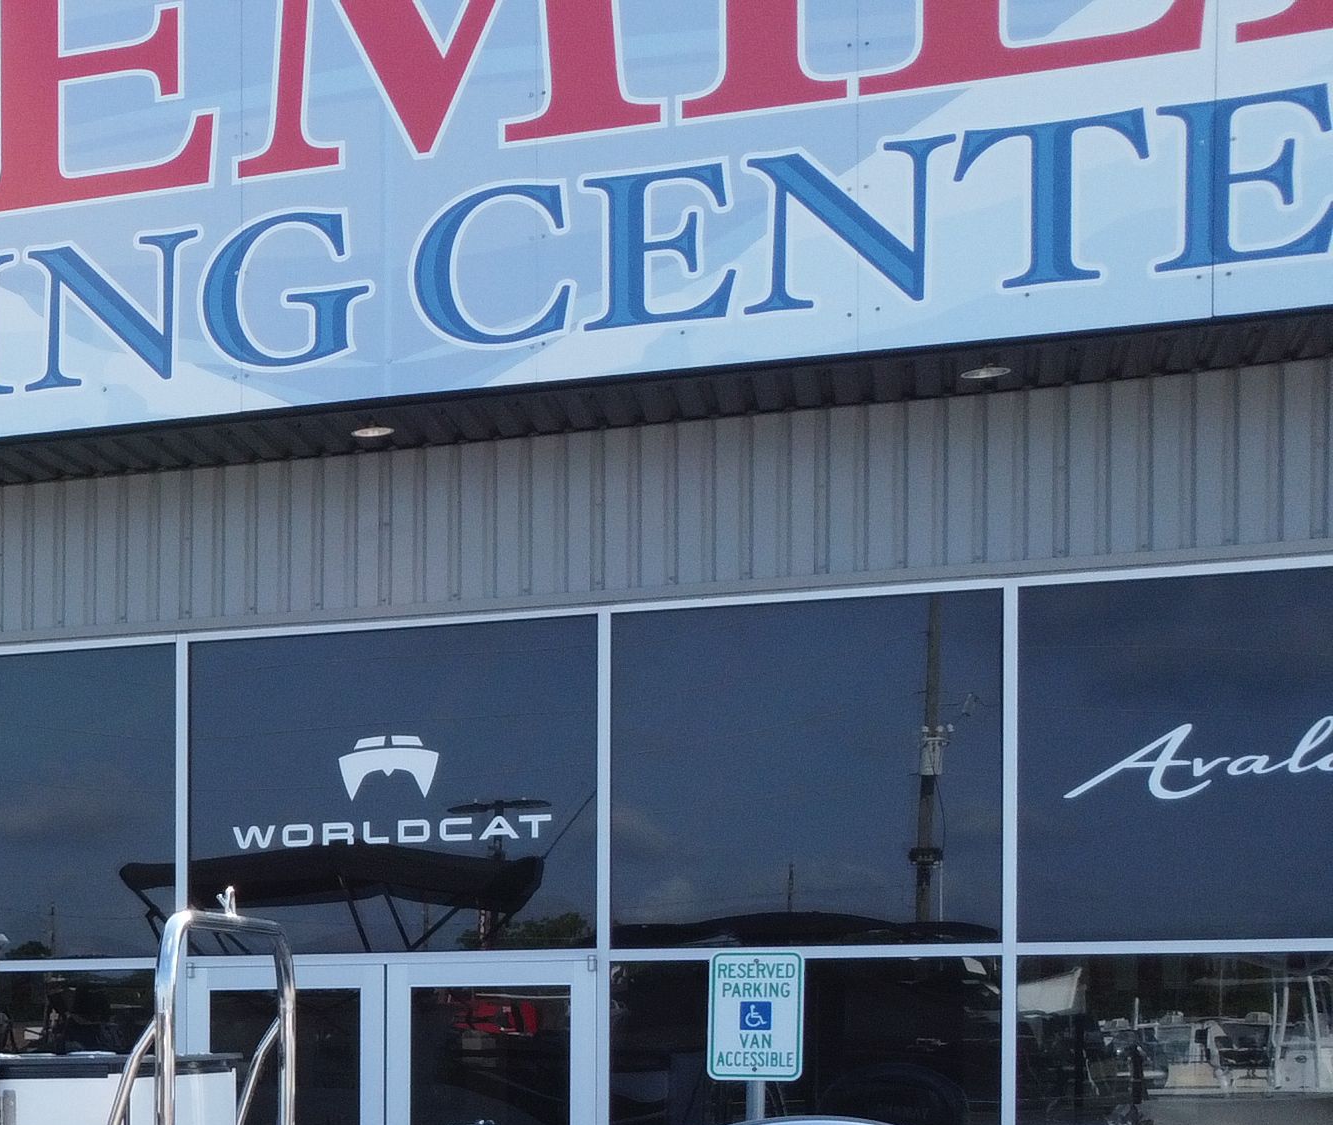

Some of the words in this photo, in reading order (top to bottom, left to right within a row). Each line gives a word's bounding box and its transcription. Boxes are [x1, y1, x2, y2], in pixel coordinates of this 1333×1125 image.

[233, 813, 552, 850] WORLDCAT
[717, 962, 796, 979] RESERVED
[721, 982, 791, 998] PARKING
[739, 1033, 773, 1049] VAN
[716, 1051, 794, 1067] ACCESSIBLE
